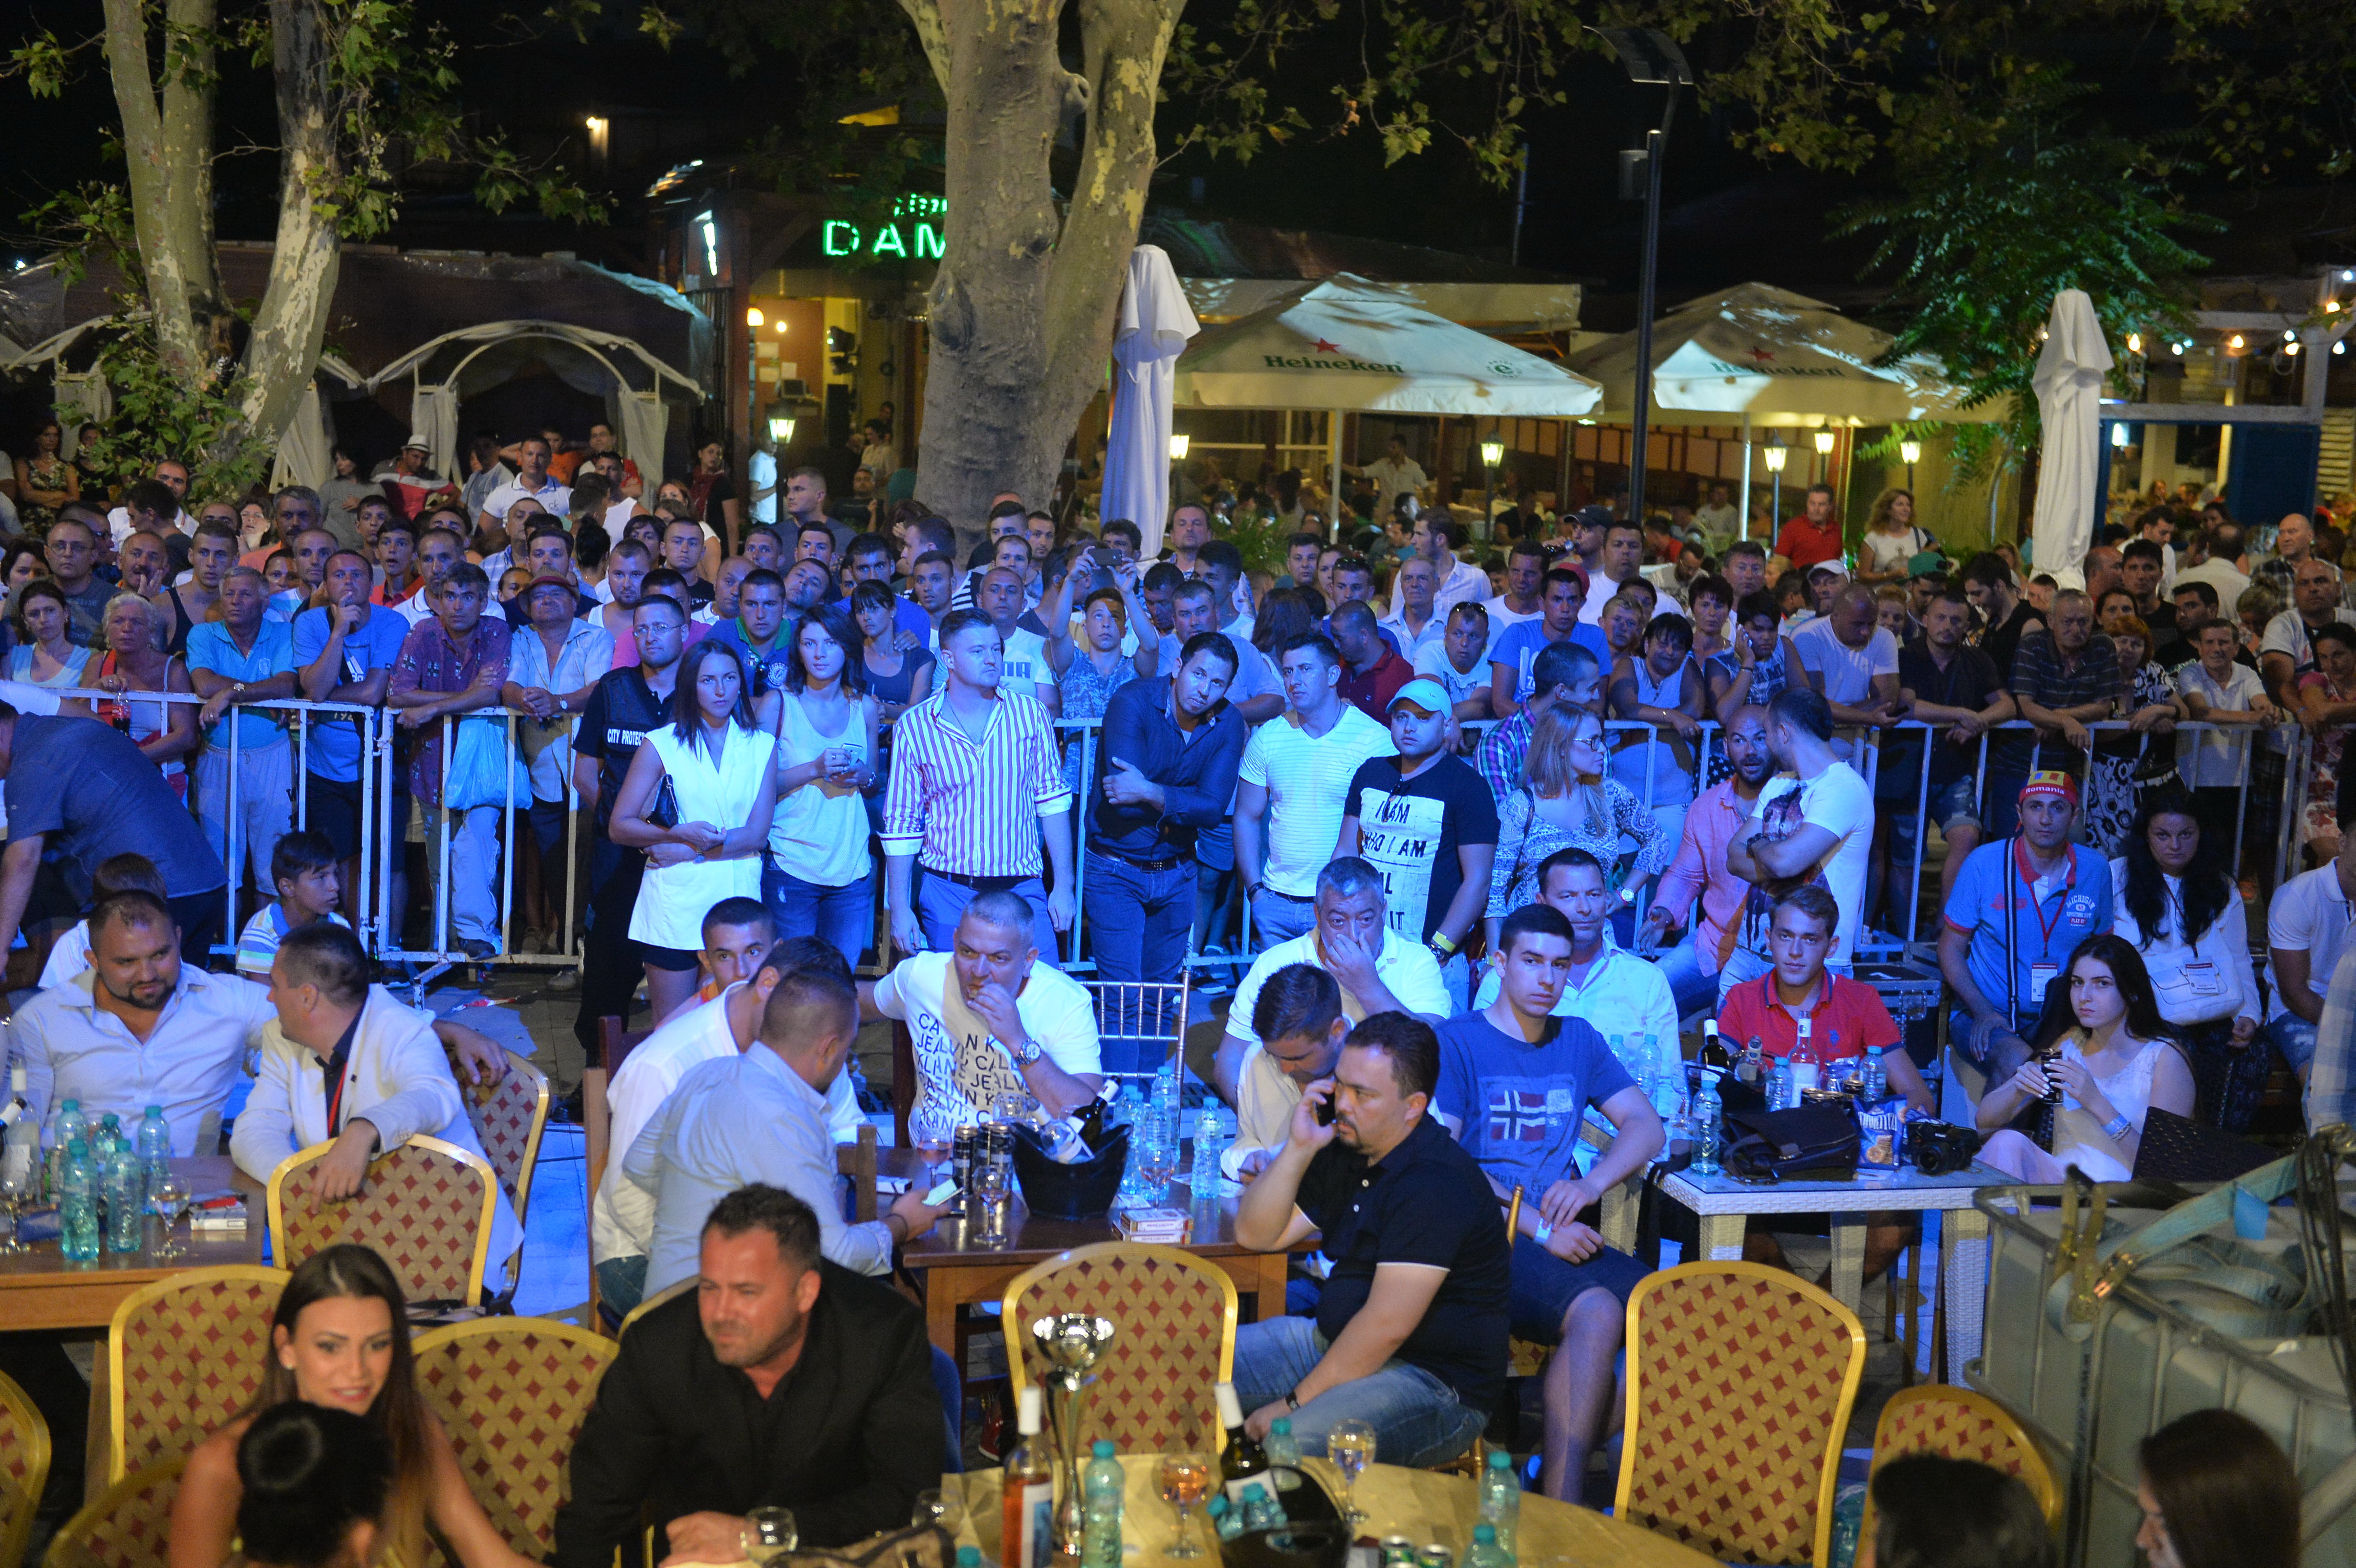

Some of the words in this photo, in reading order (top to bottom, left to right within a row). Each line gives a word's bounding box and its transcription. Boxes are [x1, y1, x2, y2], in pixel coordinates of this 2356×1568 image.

[1264, 355, 1405, 373] Heineken
[607, 728, 620, 744] CITY
[2026, 786, 2064, 795] Romania
[1375, 800, 1385, 818] I
[1388, 803, 1410, 824] AM
[1387, 836, 1396, 854] I
[1397, 839, 1427, 858] AM
[1389, 910, 1405, 930] IT
